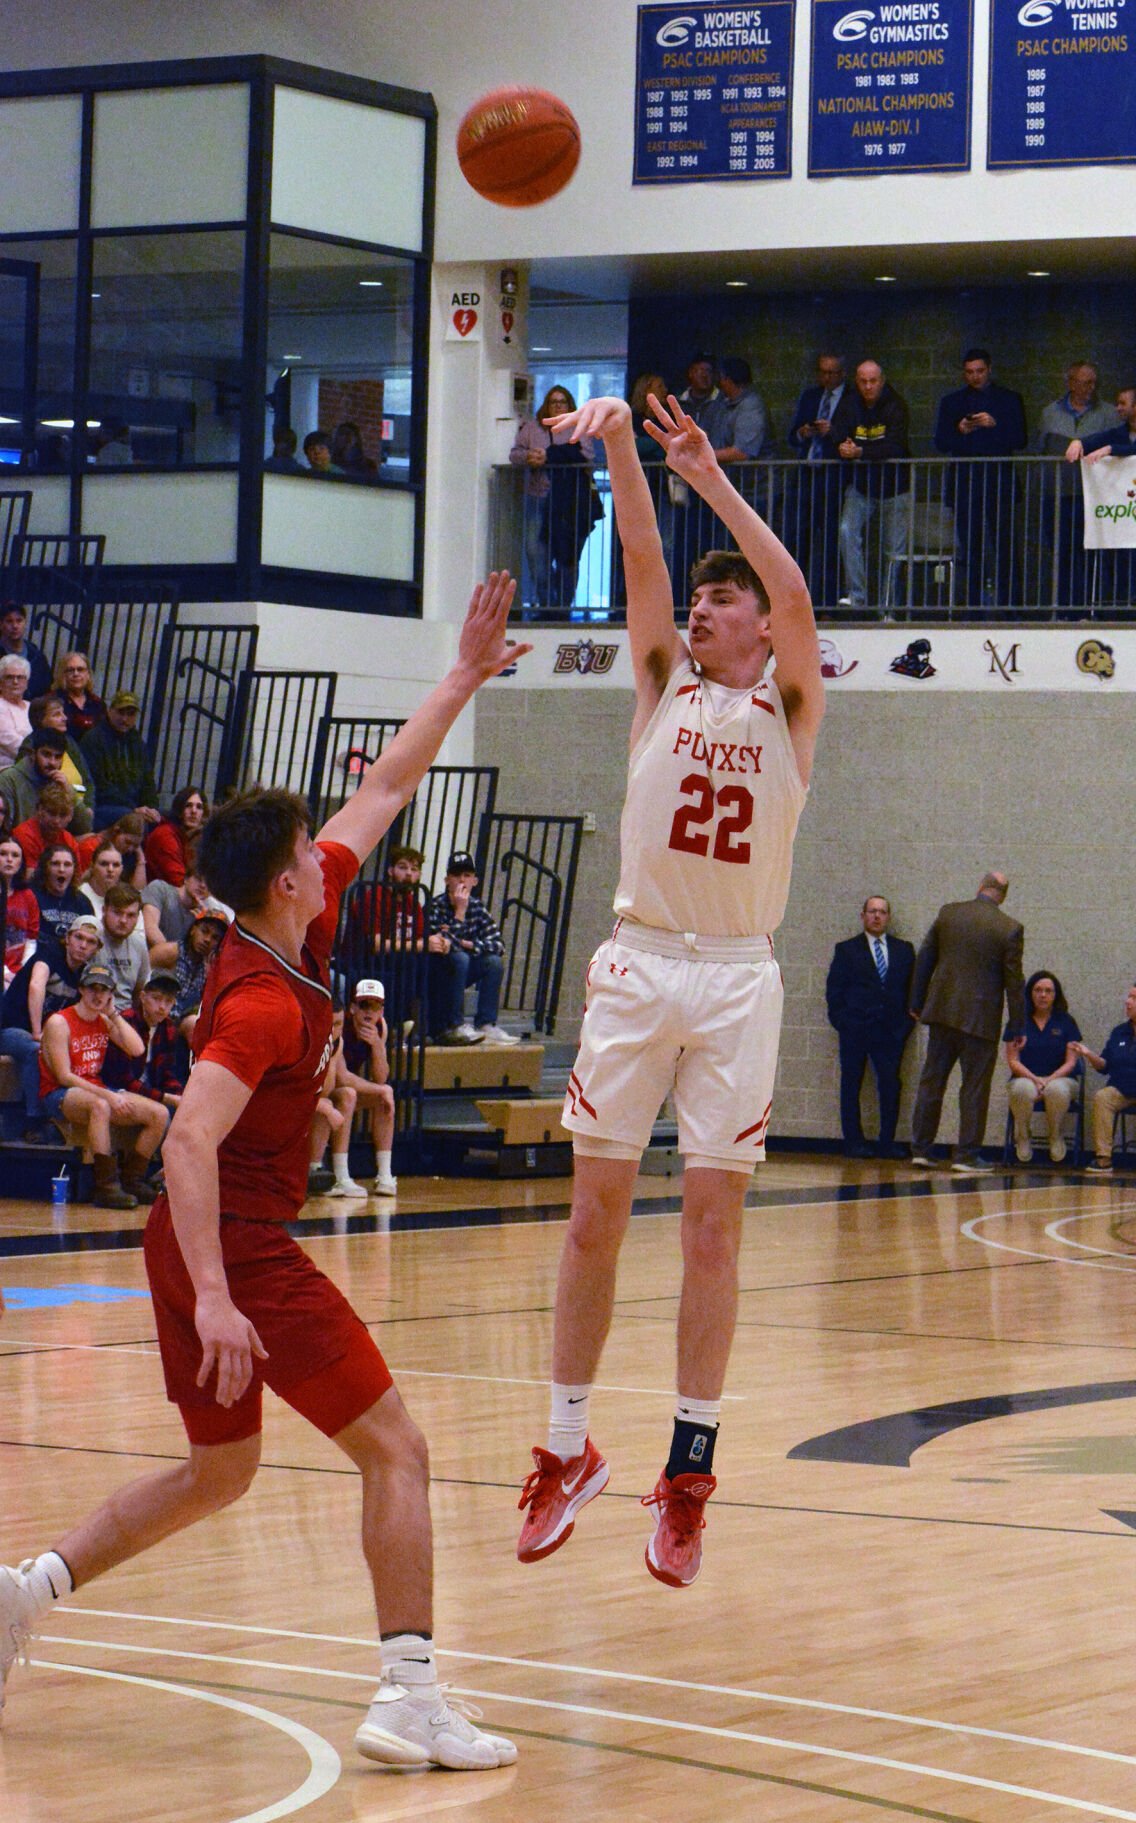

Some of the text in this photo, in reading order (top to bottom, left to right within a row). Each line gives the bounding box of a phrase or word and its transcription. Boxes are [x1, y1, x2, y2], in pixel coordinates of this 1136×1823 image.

[704, 11, 761, 29] WOMEN'S
[880, 3, 940, 23] WOMEN'S
[1071, 12, 1117, 31] TENNIS
[695, 28, 772, 48] BASKETBALL
[869, 23, 949, 44] GYMNASTICS
[1017, 35, 1128, 56] PSAC CHAMPIONS
[662, 48, 767, 69] PSAC CHAMPIONS
[836, 49, 945, 70] PSAC CHAMPIONS
[855, 73, 919, 87] 1981 1982 1983
[647, 89, 712, 102] 1987 1992 1995
[723, 85, 786, 99] 1991 1993 1994
[1026, 85, 1045, 97] 1987
[818, 92, 955, 114] NATIONAL CHAMPIONS
[646, 121, 688, 134] 1991 1994
[1026, 118, 1045, 130] 1989
[730, 131, 775, 143] 1991 1994
[1025, 134, 1045, 146] 1990
[729, 144, 775, 157] 1992 1995
[864, 143, 906, 156] 1976 1977
[656, 155, 698, 168] 1992 1994
[729, 158, 775, 170] 1993 2005
[451, 293, 480, 306] AED
[668, 773, 754, 864] 22
